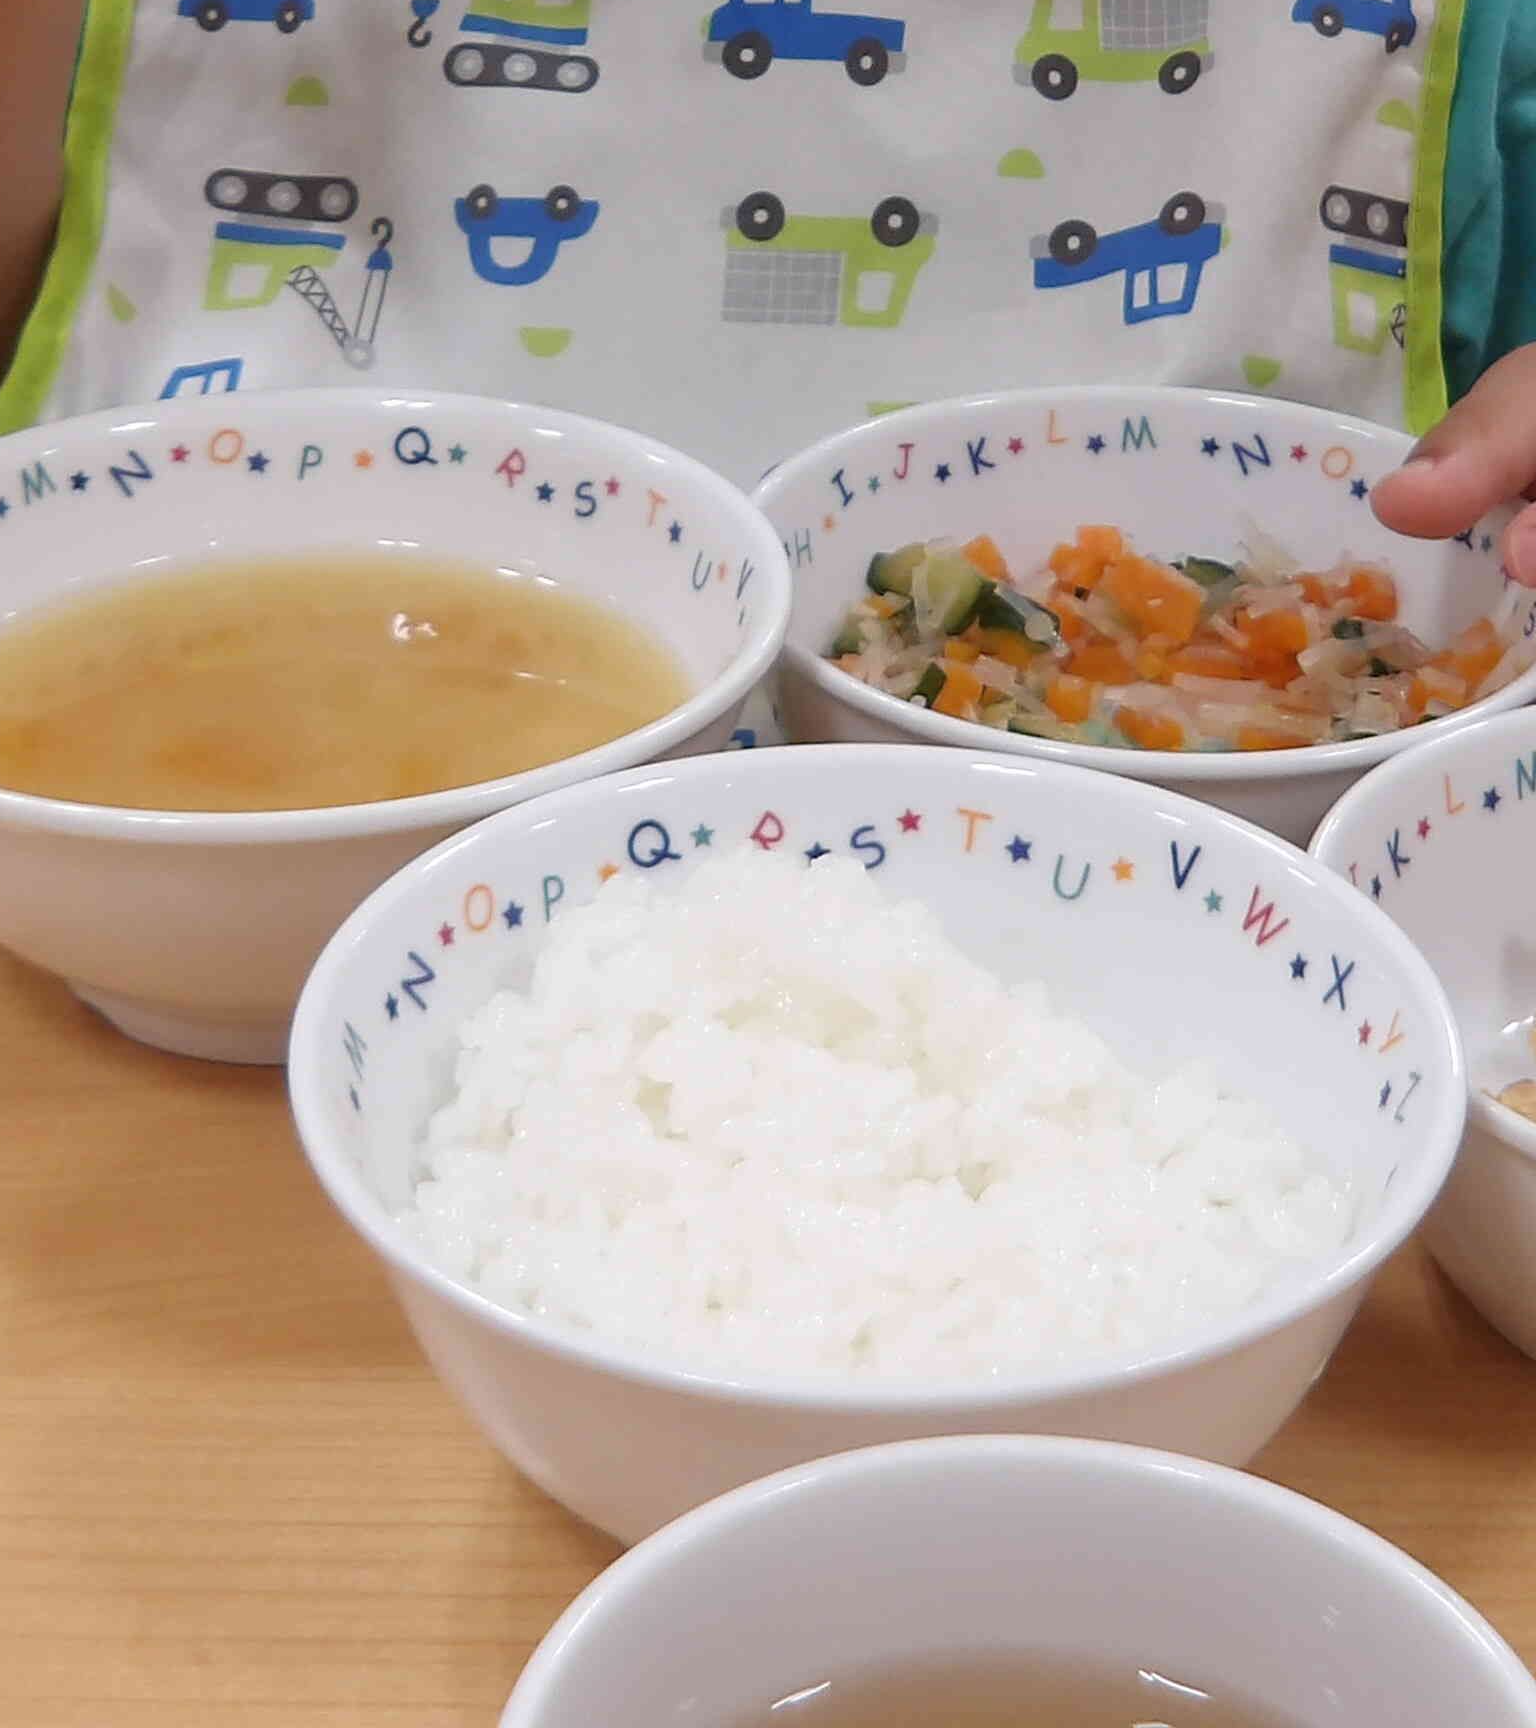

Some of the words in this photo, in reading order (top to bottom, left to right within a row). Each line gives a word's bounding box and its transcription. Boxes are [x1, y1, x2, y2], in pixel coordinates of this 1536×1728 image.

[21, 461, 56, 504] M
[109, 451, 153, 498] N
[208, 429, 243, 464] O
[297, 445, 323, 480] P
[394, 427, 438, 465] Q
[496, 448, 526, 488] R
[575, 481, 597, 518] S
[647, 488, 668, 528] T
[692, 552, 712, 592] U
[736, 559, 754, 600] V
[794, 528, 812, 568] H
[832, 469, 854, 507] I
[894, 443, 915, 480] J
[967, 437, 995, 476] K
[1046, 409, 1068, 446] L
[1122, 416, 1157, 452] M
[1232, 434, 1271, 476] N
[1321, 446, 1352, 478] O
[1387, 829, 1410, 878] K
[1444, 773, 1466, 816] L
[400, 951, 435, 1012] N
[465, 884, 493, 932] O
[542, 875, 564, 922] P
[628, 819, 682, 868] Q
[750, 811, 784, 850] R
[850, 826, 885, 870] S
[956, 808, 994, 853] T
[1053, 854, 1090, 901] U
[1171, 841, 1201, 890] V
[1243, 885, 1289, 947] W
[1323, 955, 1355, 1011] X
